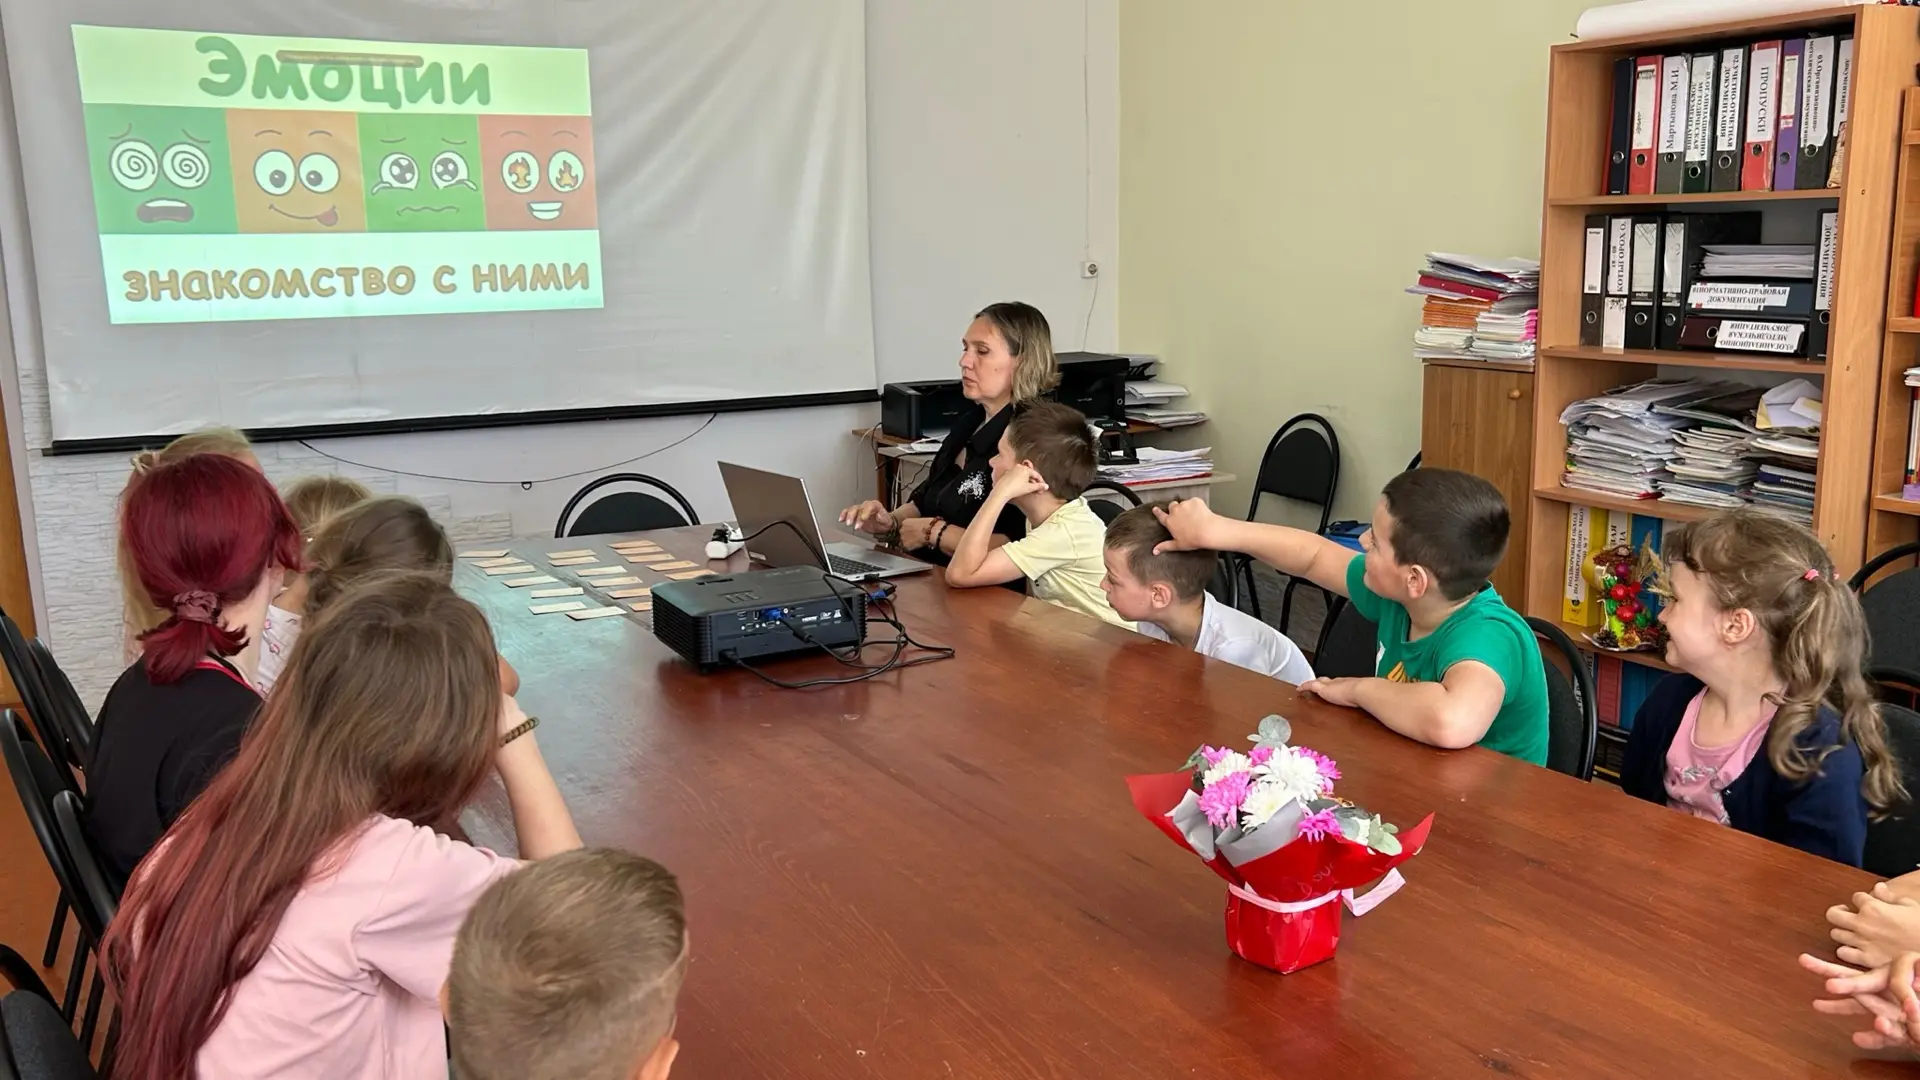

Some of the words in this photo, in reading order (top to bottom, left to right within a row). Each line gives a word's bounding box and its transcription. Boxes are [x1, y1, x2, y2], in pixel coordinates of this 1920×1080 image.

[195, 36, 491, 110] Эмоции
[1720, 66, 1731, 138] ДОКУМЕНТАЦИЯ
[1757, 67, 1770, 133] ПРОПУСКИ
[1665, 93, 1678, 149] Мартынова
[1686, 83, 1696, 151] ДОКУМЕНТАЦИЯ
[1693, 82, 1703, 150] МЕТОДИЧЕСКАЯ
[122, 265, 416, 302] знакомство
[432, 265, 458, 294] с
[472, 262, 590, 293] ними
[1819, 224, 1832, 298] ДОКУМЕНТАЦИЯ
[1707, 296, 1767, 304] ДОКУМЕНТАЦИЯ
[1729, 323, 1791, 332] ДОКУМЕНТАЦИЯ
[1728, 332, 1788, 341] МЕТОДИЧЕСКАЯ
